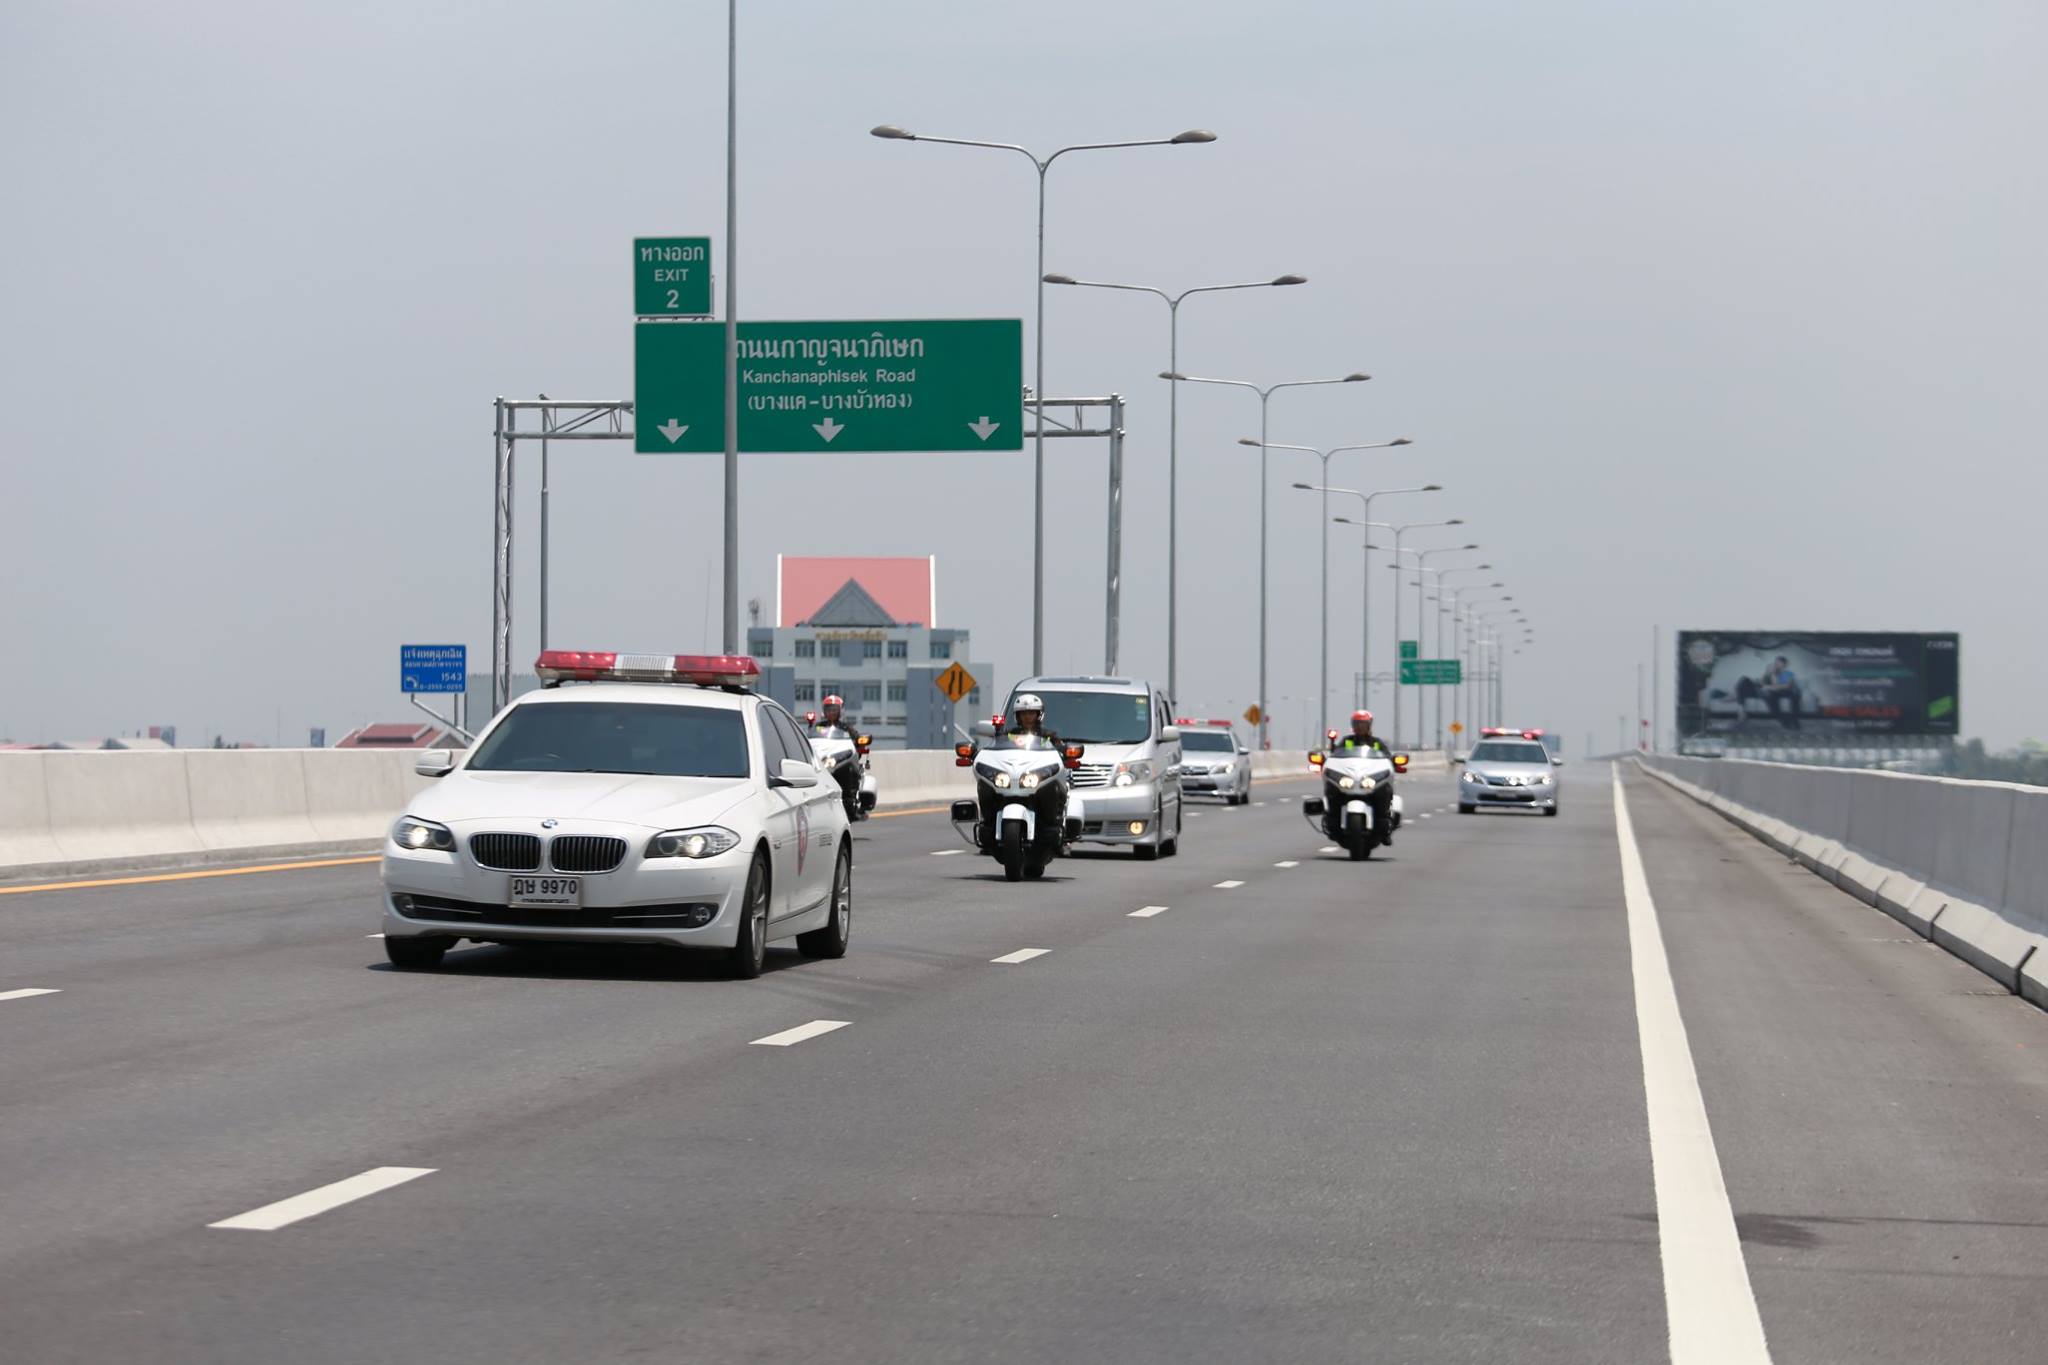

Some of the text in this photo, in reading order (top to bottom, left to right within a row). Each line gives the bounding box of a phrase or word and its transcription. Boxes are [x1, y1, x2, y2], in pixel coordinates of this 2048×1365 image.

[641, 246, 704, 262] ทางออก
[654, 268, 690, 282] EXIT
[666, 289, 680, 309] 2
[742, 368, 916, 386] Kanchanaphisek Road
[441, 672, 462, 681] 1543
[541, 879, 577, 894] 9970
